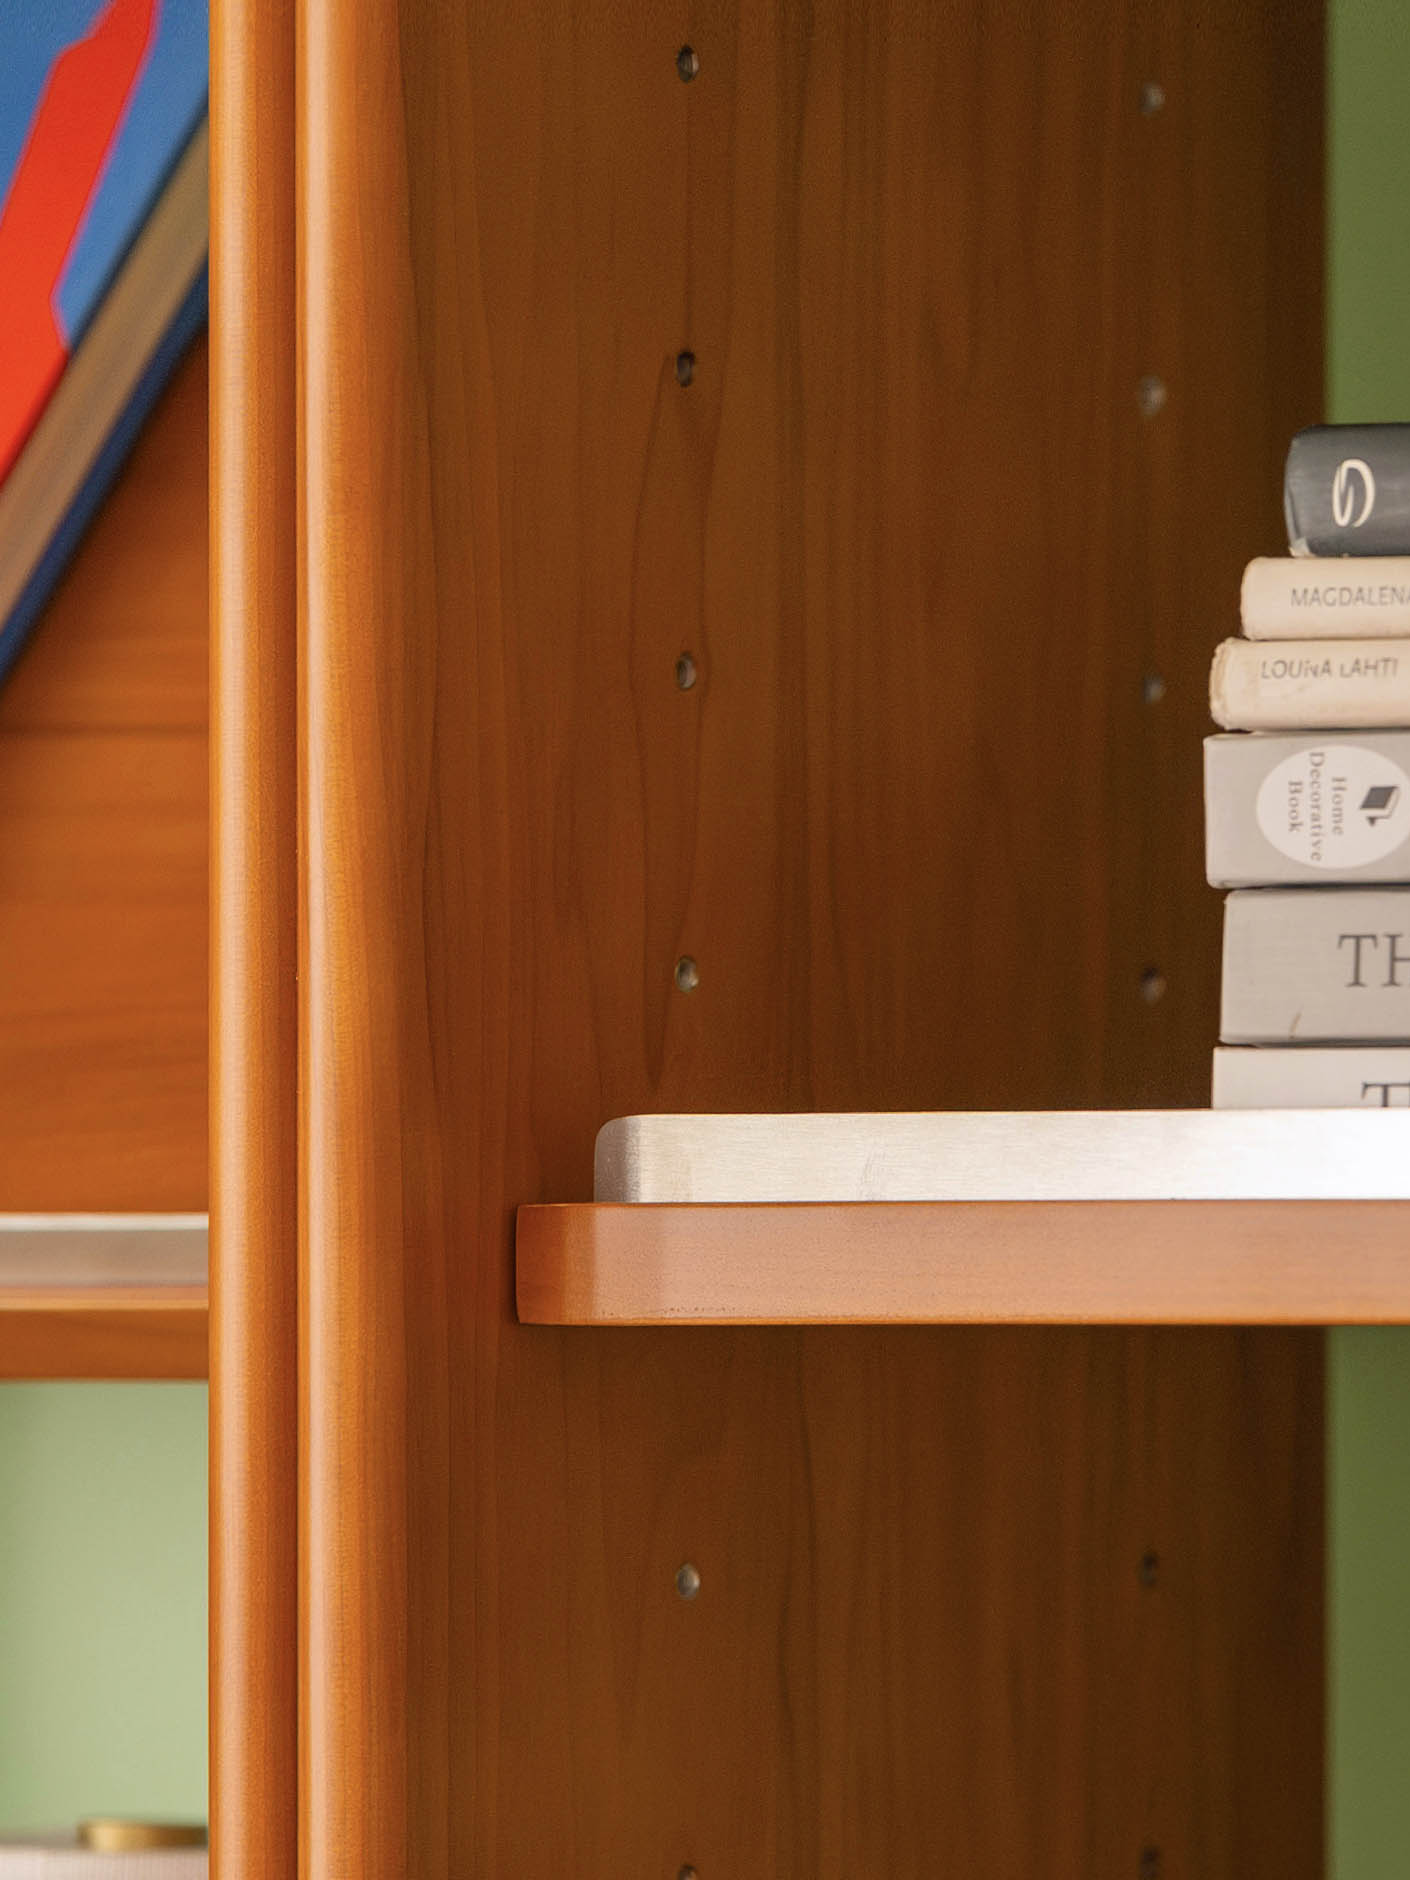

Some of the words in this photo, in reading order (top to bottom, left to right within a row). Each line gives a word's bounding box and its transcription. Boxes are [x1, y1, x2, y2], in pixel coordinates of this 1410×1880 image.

[1339, 656, 1399, 678] LAHTI
[1287, 780, 1304, 833] Book
[1308, 751, 1326, 862] Decorative
[1331, 776, 1348, 836] Home
